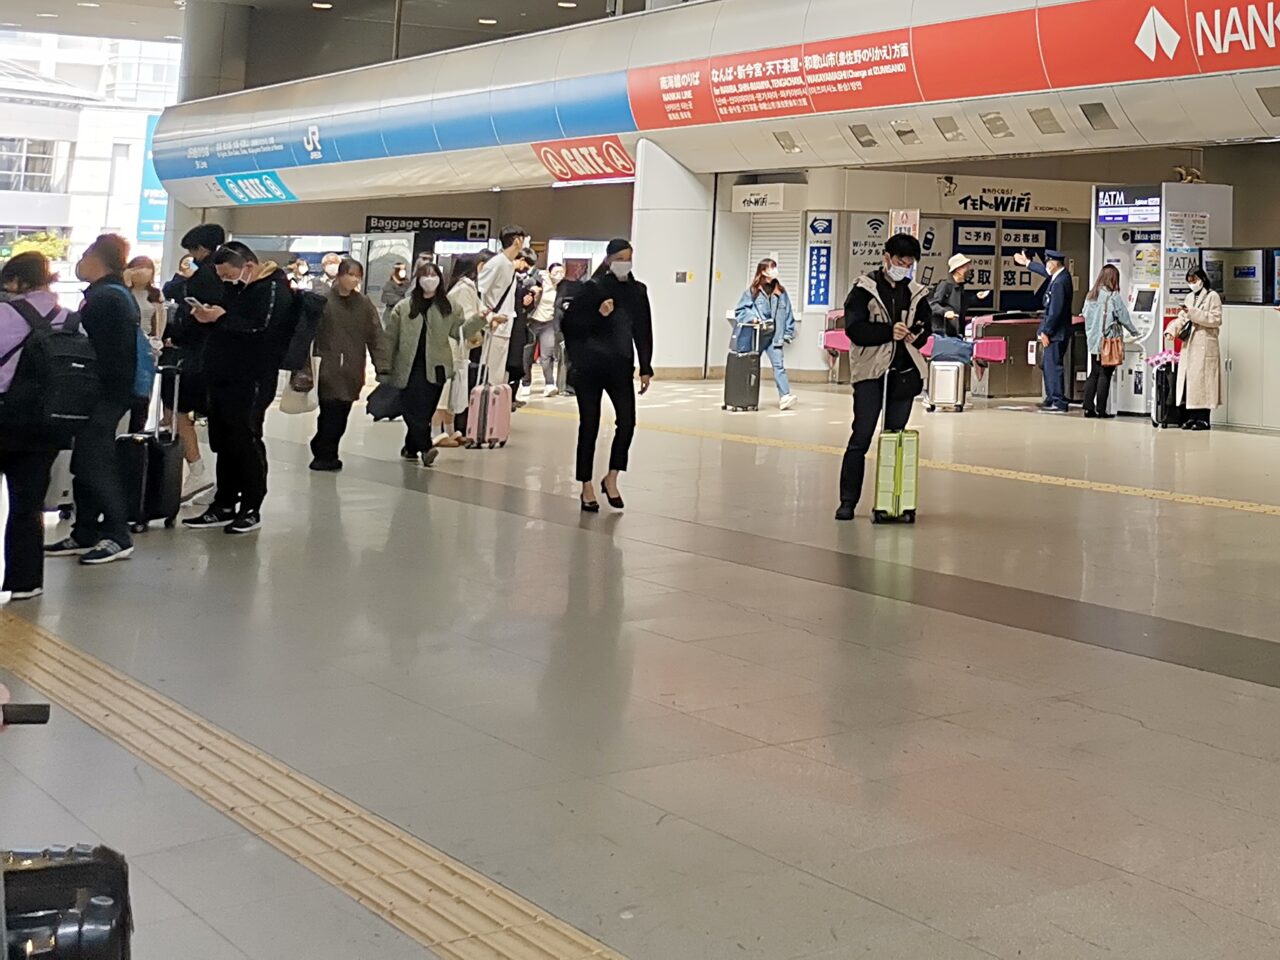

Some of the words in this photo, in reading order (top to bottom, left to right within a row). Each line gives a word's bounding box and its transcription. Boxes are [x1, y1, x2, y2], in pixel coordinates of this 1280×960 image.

[303, 126, 321, 151] JR
[560, 146, 614, 176] GATE
[1104, 191, 1125, 205] ATM
[370, 217, 420, 231] Baggage
[422, 218, 464, 231] Storage
[964, 231, 992, 242] ご予約
[1173, 256, 1197, 269] ATM
[1003, 270, 1031, 286] 窓口
